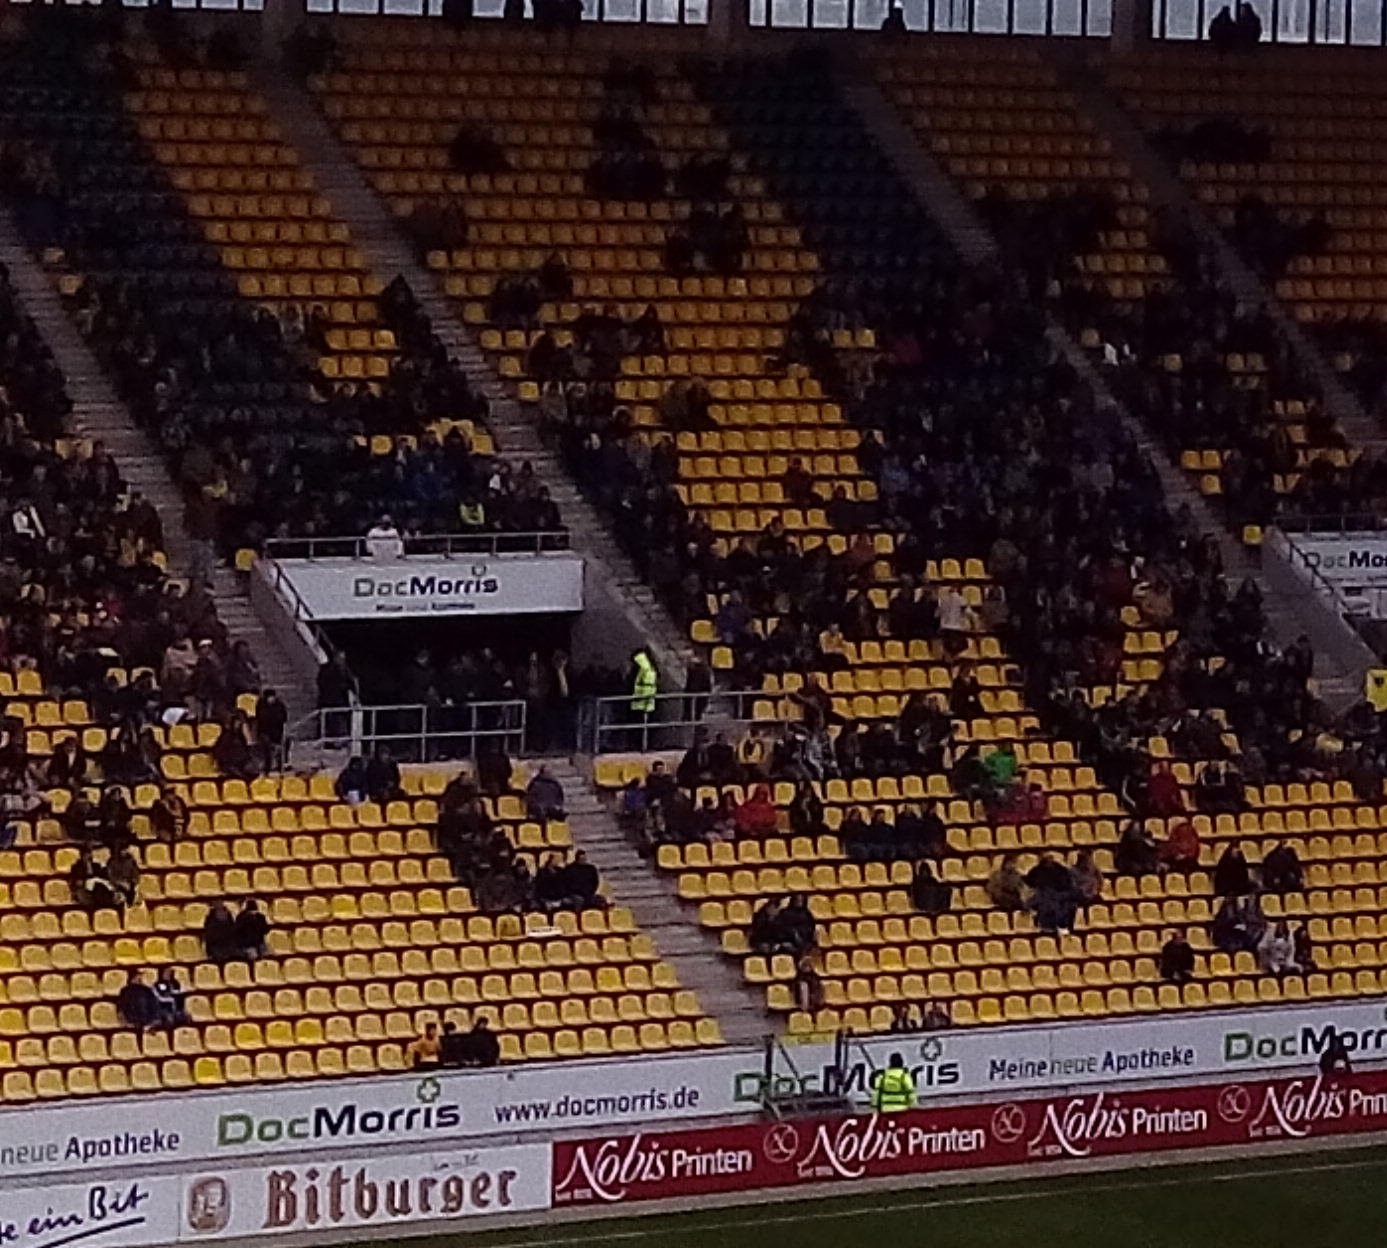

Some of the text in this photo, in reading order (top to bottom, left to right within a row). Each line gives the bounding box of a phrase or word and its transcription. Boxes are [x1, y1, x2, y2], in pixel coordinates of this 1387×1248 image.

[353, 575, 498, 598] DocMorris
[989, 1045, 1194, 1081] Meine neue Apotheke
[216, 1104, 460, 1146] DocMorris
[494, 1087, 699, 1123] www.docmorris.de
[1027, 1091, 1208, 1156] Nobis Printen
[1248, 1073, 1347, 1137] Nobis
[0, 1128, 180, 1165] neue Apotheke
[555, 1133, 753, 1201] Nobis Printen
[796, 1112, 986, 1178] Nobis Printen
[28, 1206, 84, 1235] ein
[89, 1182, 149, 1221] Bit
[262, 1165, 517, 1229] Bitburger
